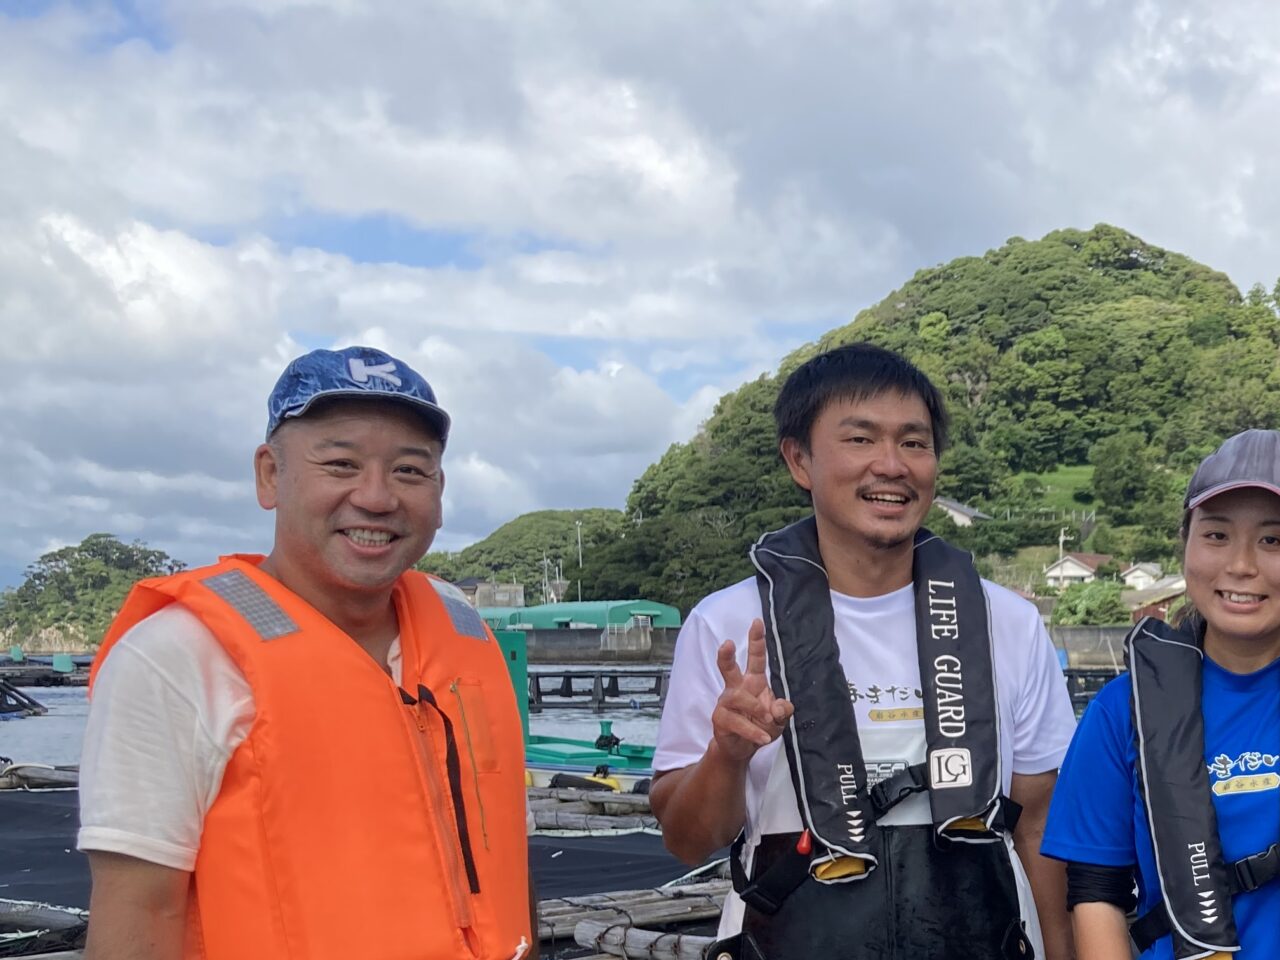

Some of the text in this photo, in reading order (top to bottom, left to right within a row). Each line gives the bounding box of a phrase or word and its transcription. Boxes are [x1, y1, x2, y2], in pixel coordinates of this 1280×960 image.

[348, 358, 402, 387] K
[927, 578, 966, 738] LIFE GUARD
[837, 763, 857, 805] PULL
[1187, 841, 1210, 887] PULL
